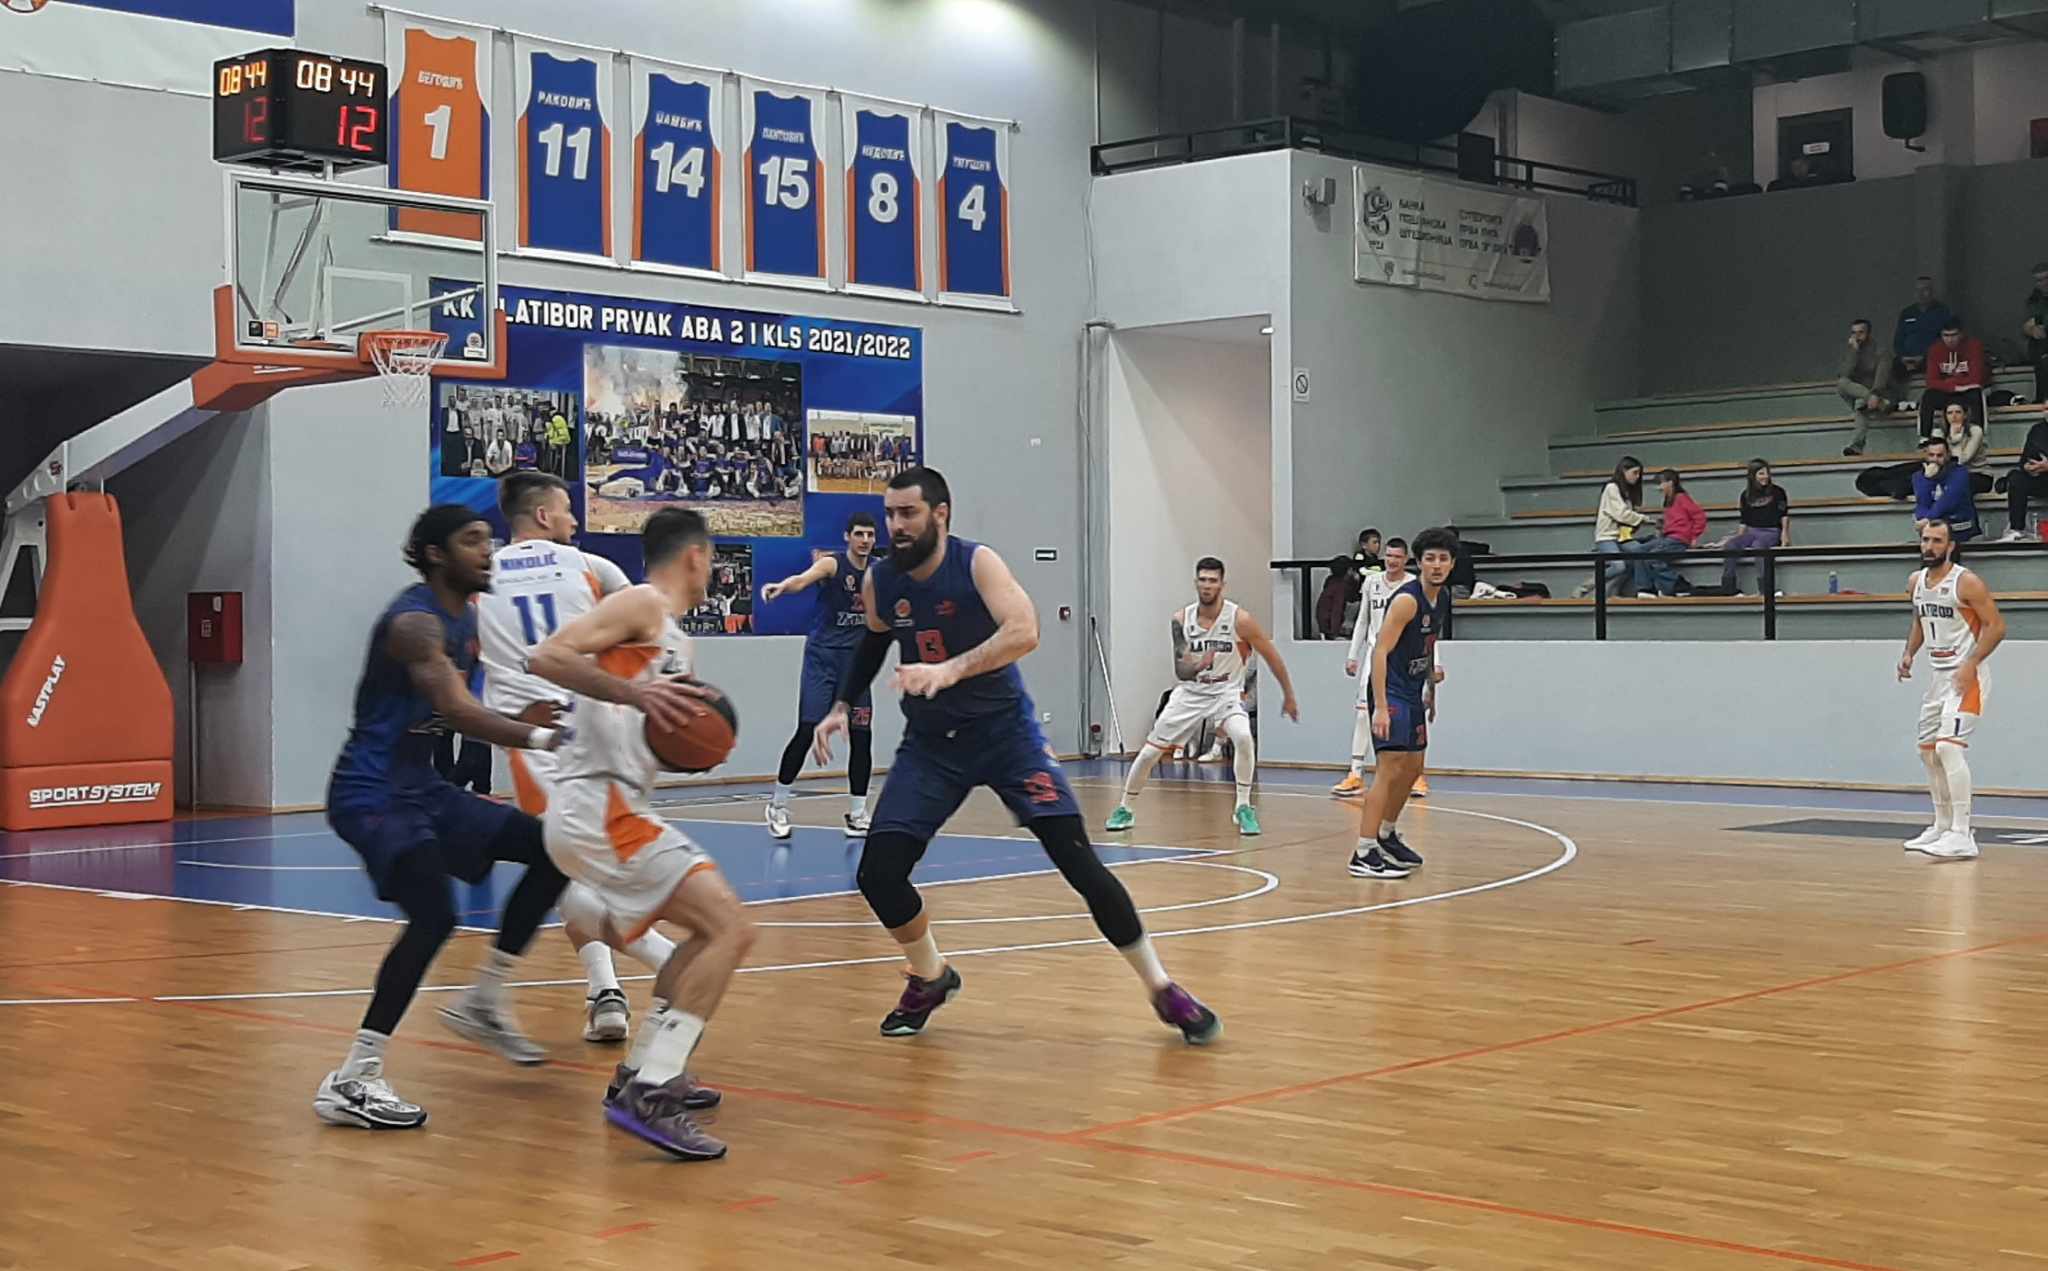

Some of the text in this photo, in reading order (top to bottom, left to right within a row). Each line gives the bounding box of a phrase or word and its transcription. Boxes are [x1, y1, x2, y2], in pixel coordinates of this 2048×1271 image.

[244, 96, 268, 143] 12
[336, 104, 378, 152] 12
[424, 104, 452, 160] 1
[538, 123, 592, 180] 11
[650, 141, 705, 198] 14
[759, 155, 810, 209] 15
[868, 172, 899, 223] 8
[958, 184, 986, 231] 4
[442, 294, 475, 319] KK
[498, 298, 593, 329] LATIBOR
[601, 307, 673, 336] PRVAK
[681, 315, 723, 342] ABA
[730, 320, 744, 344] 2
[763, 323, 802, 349] KLS
[808, 328, 911, 359] 2021/2022
[512, 593, 560, 646] 11
[29, 782, 161, 804] SPORTSYSTEM
